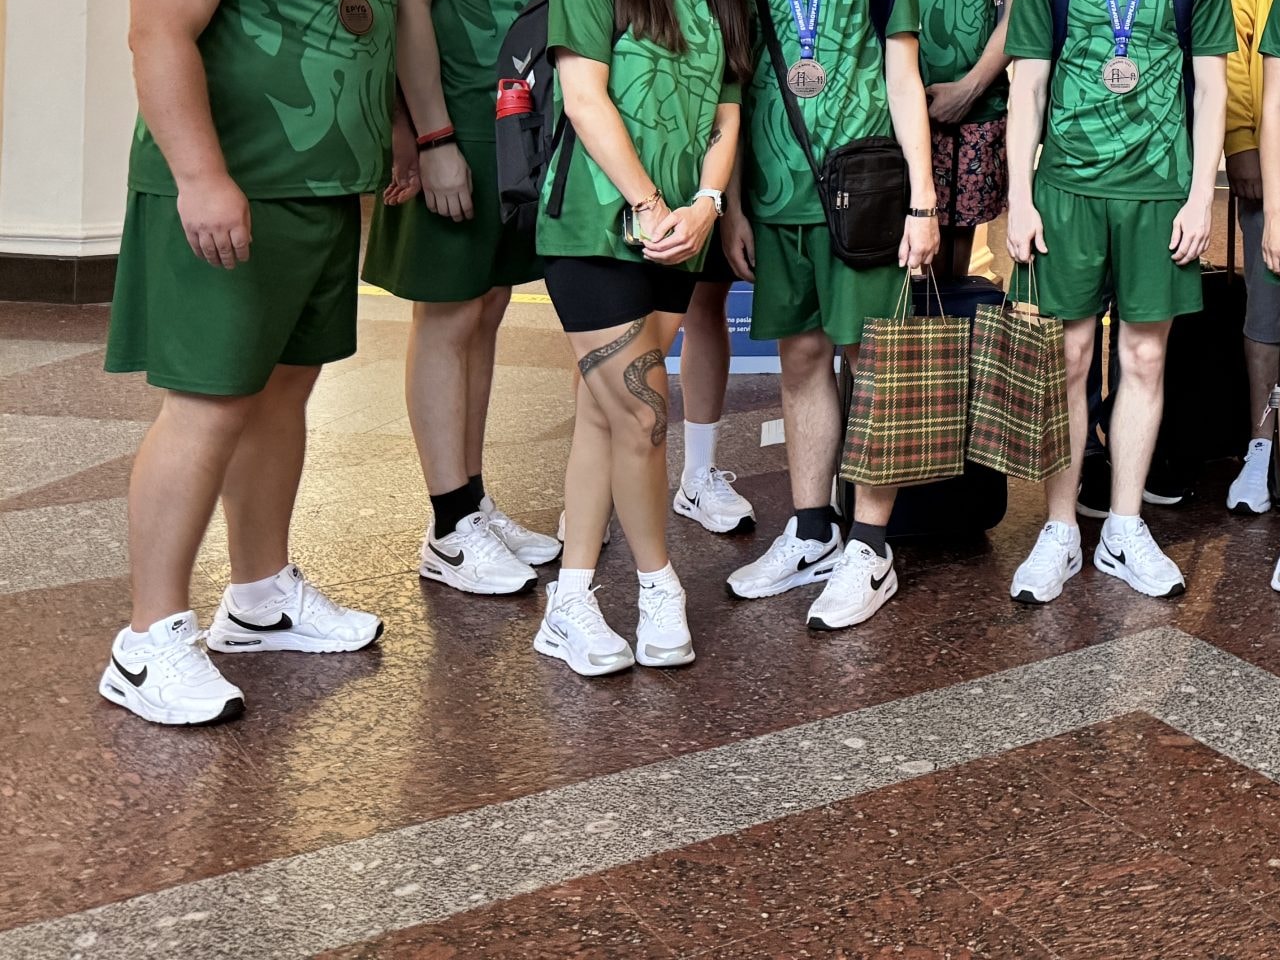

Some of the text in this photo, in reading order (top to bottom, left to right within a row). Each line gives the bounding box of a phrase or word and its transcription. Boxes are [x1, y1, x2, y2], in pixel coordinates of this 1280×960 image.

[792, 0, 806, 31] EUROPEAN
[1109, 0, 1121, 30] EUROPEAN
[1124, 0, 1136, 31] EUROPEAN
